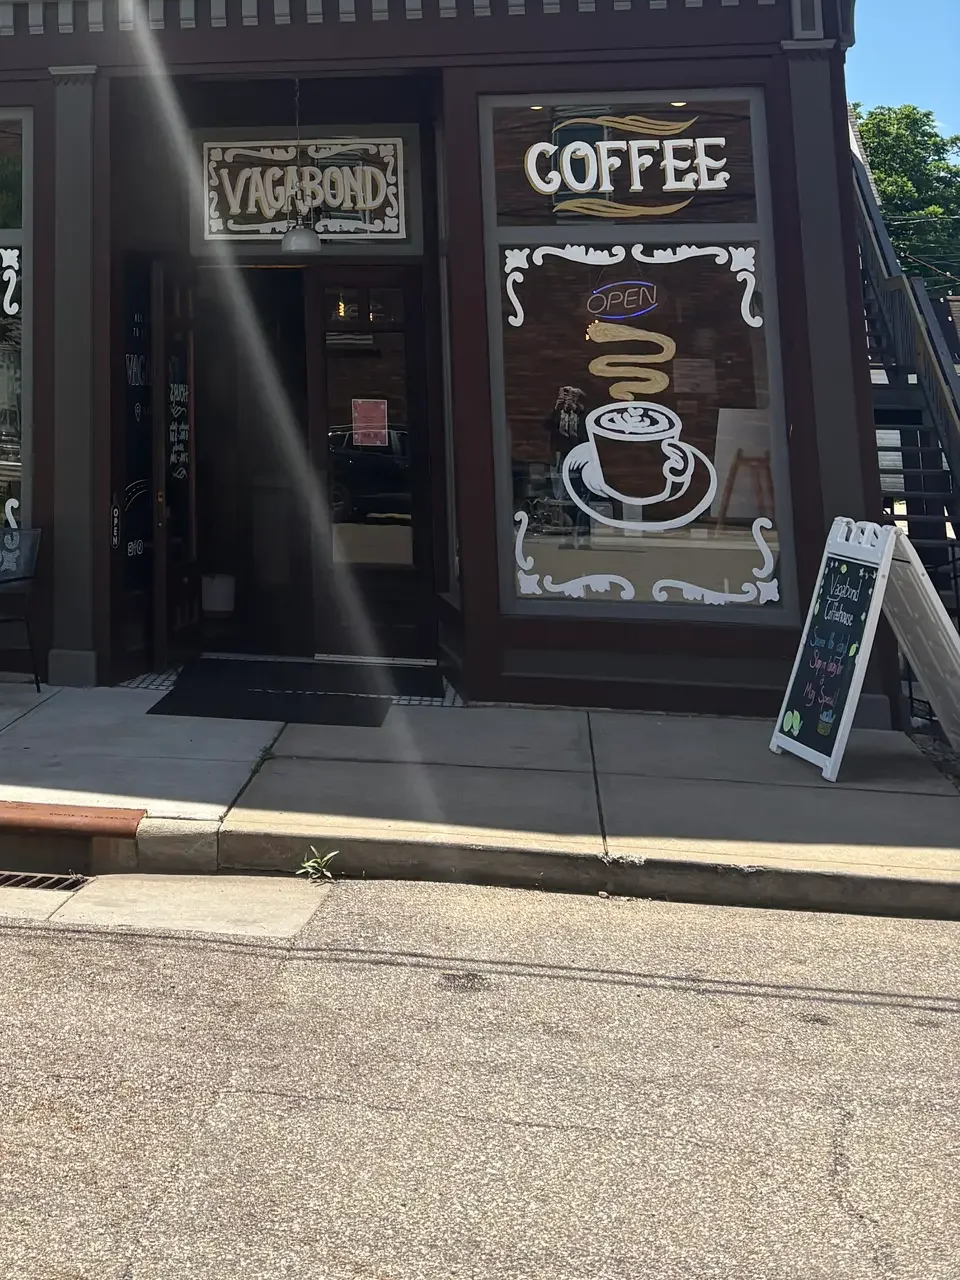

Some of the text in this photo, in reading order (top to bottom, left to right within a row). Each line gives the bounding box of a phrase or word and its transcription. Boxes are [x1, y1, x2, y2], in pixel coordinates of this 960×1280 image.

[219, 165, 388, 219] VAGABOND
[524, 137, 731, 195] COFFEE
[587, 284, 658, 314] OPEN
